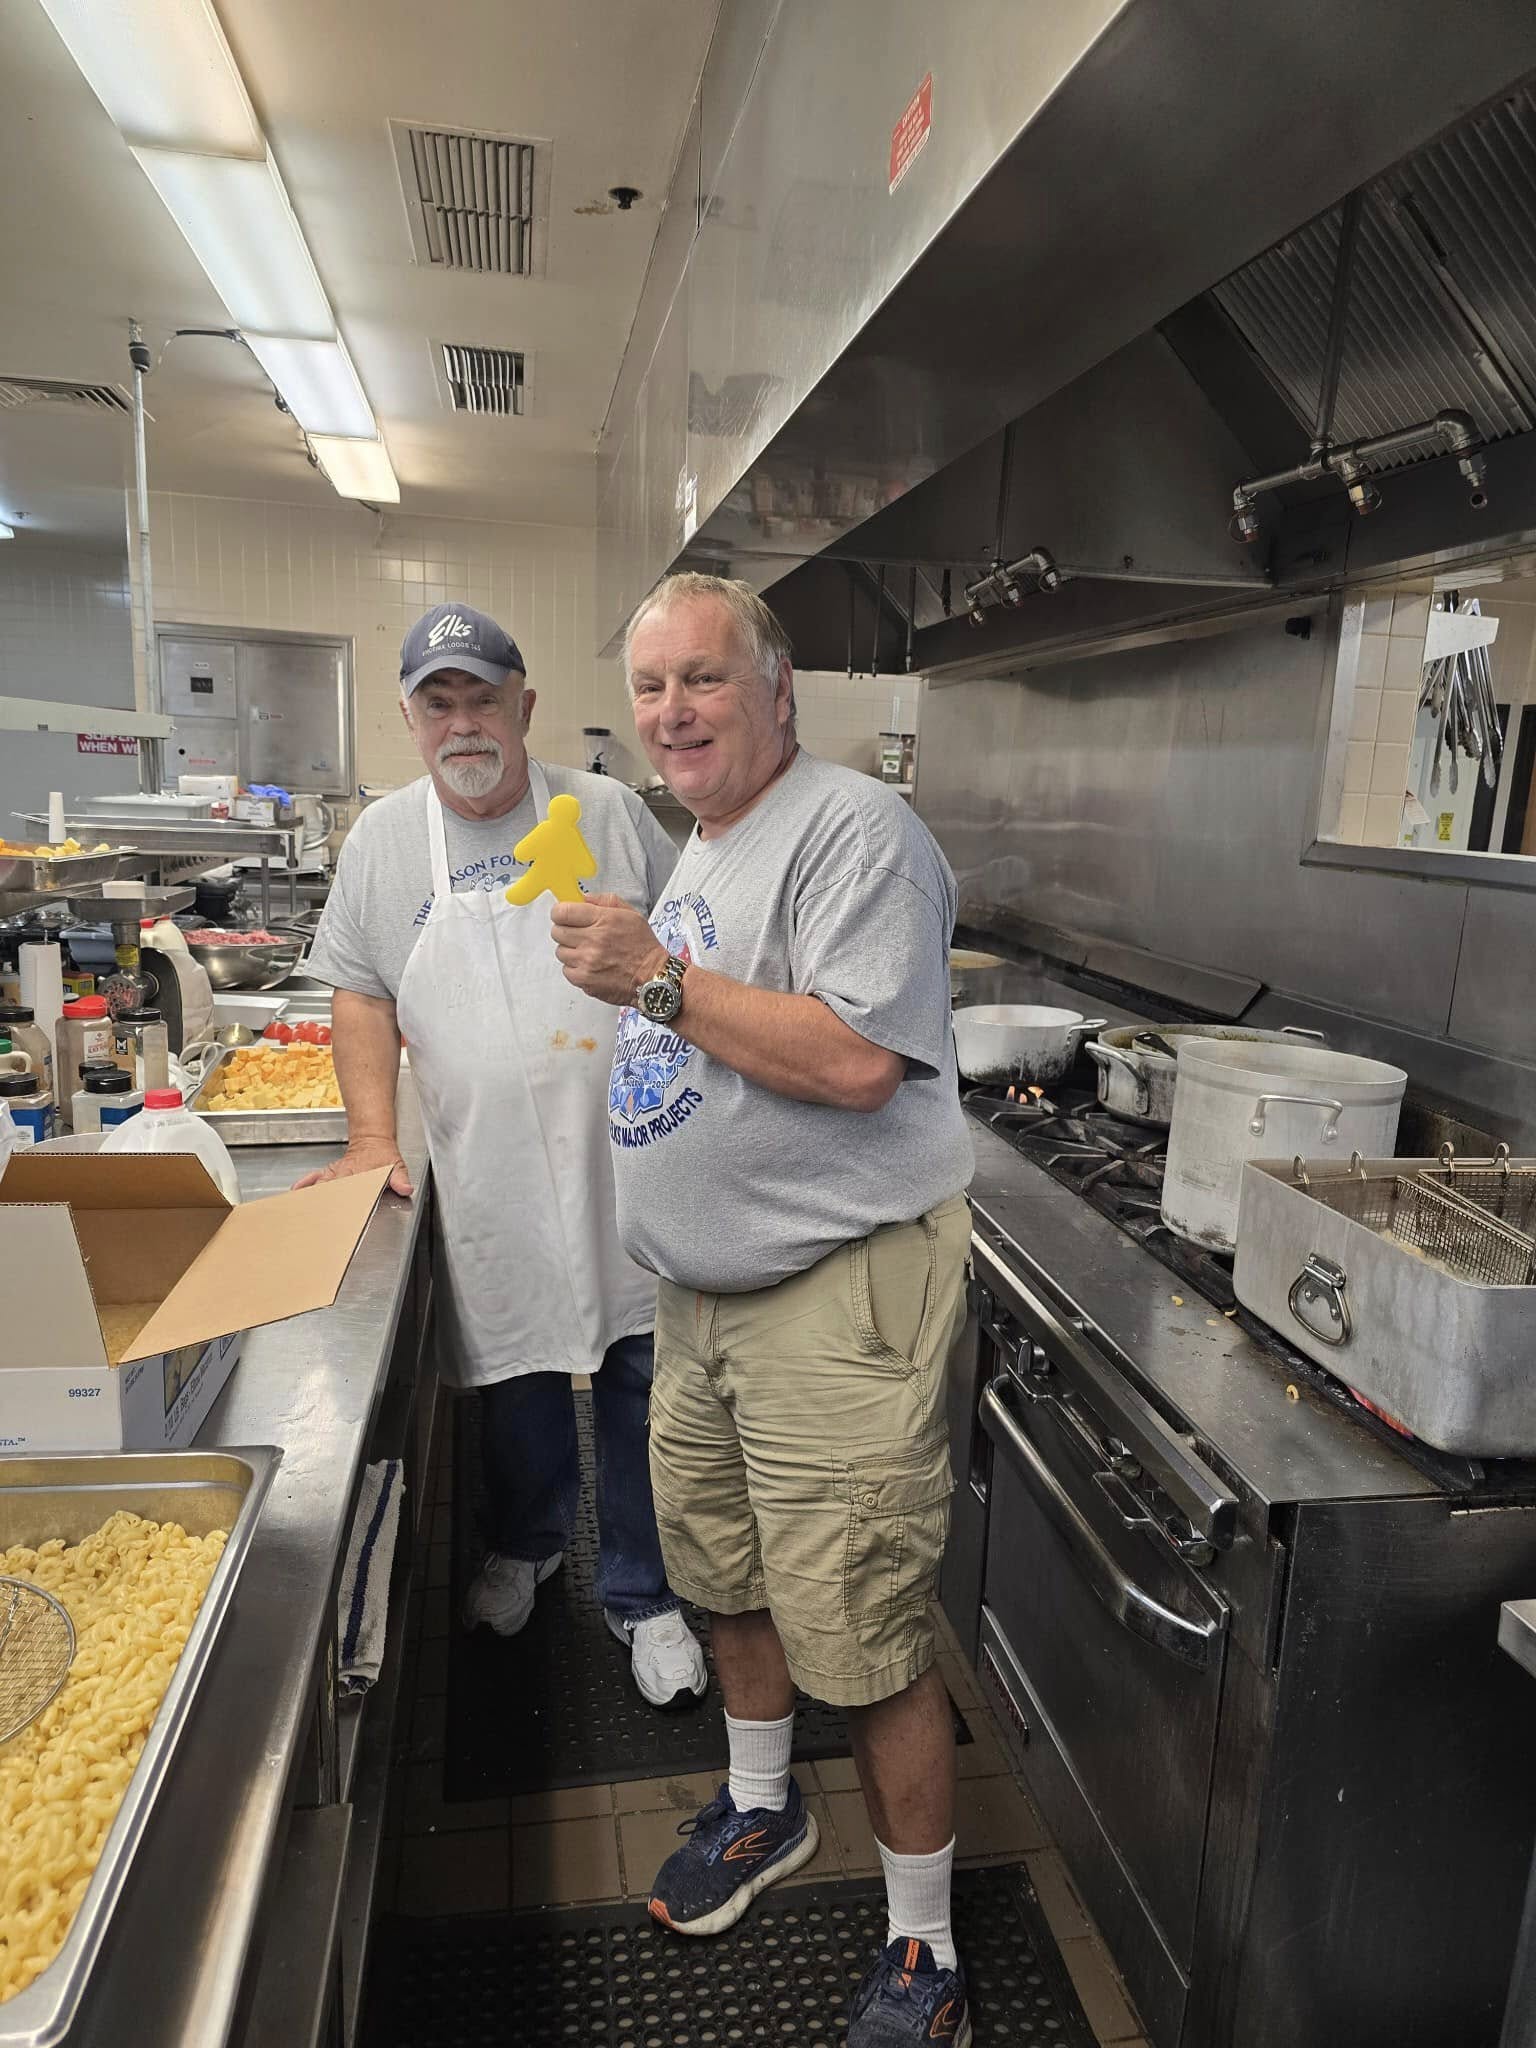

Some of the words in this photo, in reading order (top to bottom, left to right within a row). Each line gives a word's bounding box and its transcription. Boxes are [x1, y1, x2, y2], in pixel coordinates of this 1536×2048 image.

[428, 614, 473, 648] Elks
[84, 733, 136, 742] SLIPPER
[80, 741, 118, 753] WHEN
[121, 743, 140, 755] WE
[450, 860, 487, 888] ASON
[652, 1081, 670, 1089] 2025
[622, 1125, 651, 1148] MAJOR
[648, 1087, 703, 1141] PROJECTS
[68, 1388, 101, 1398] 99327
